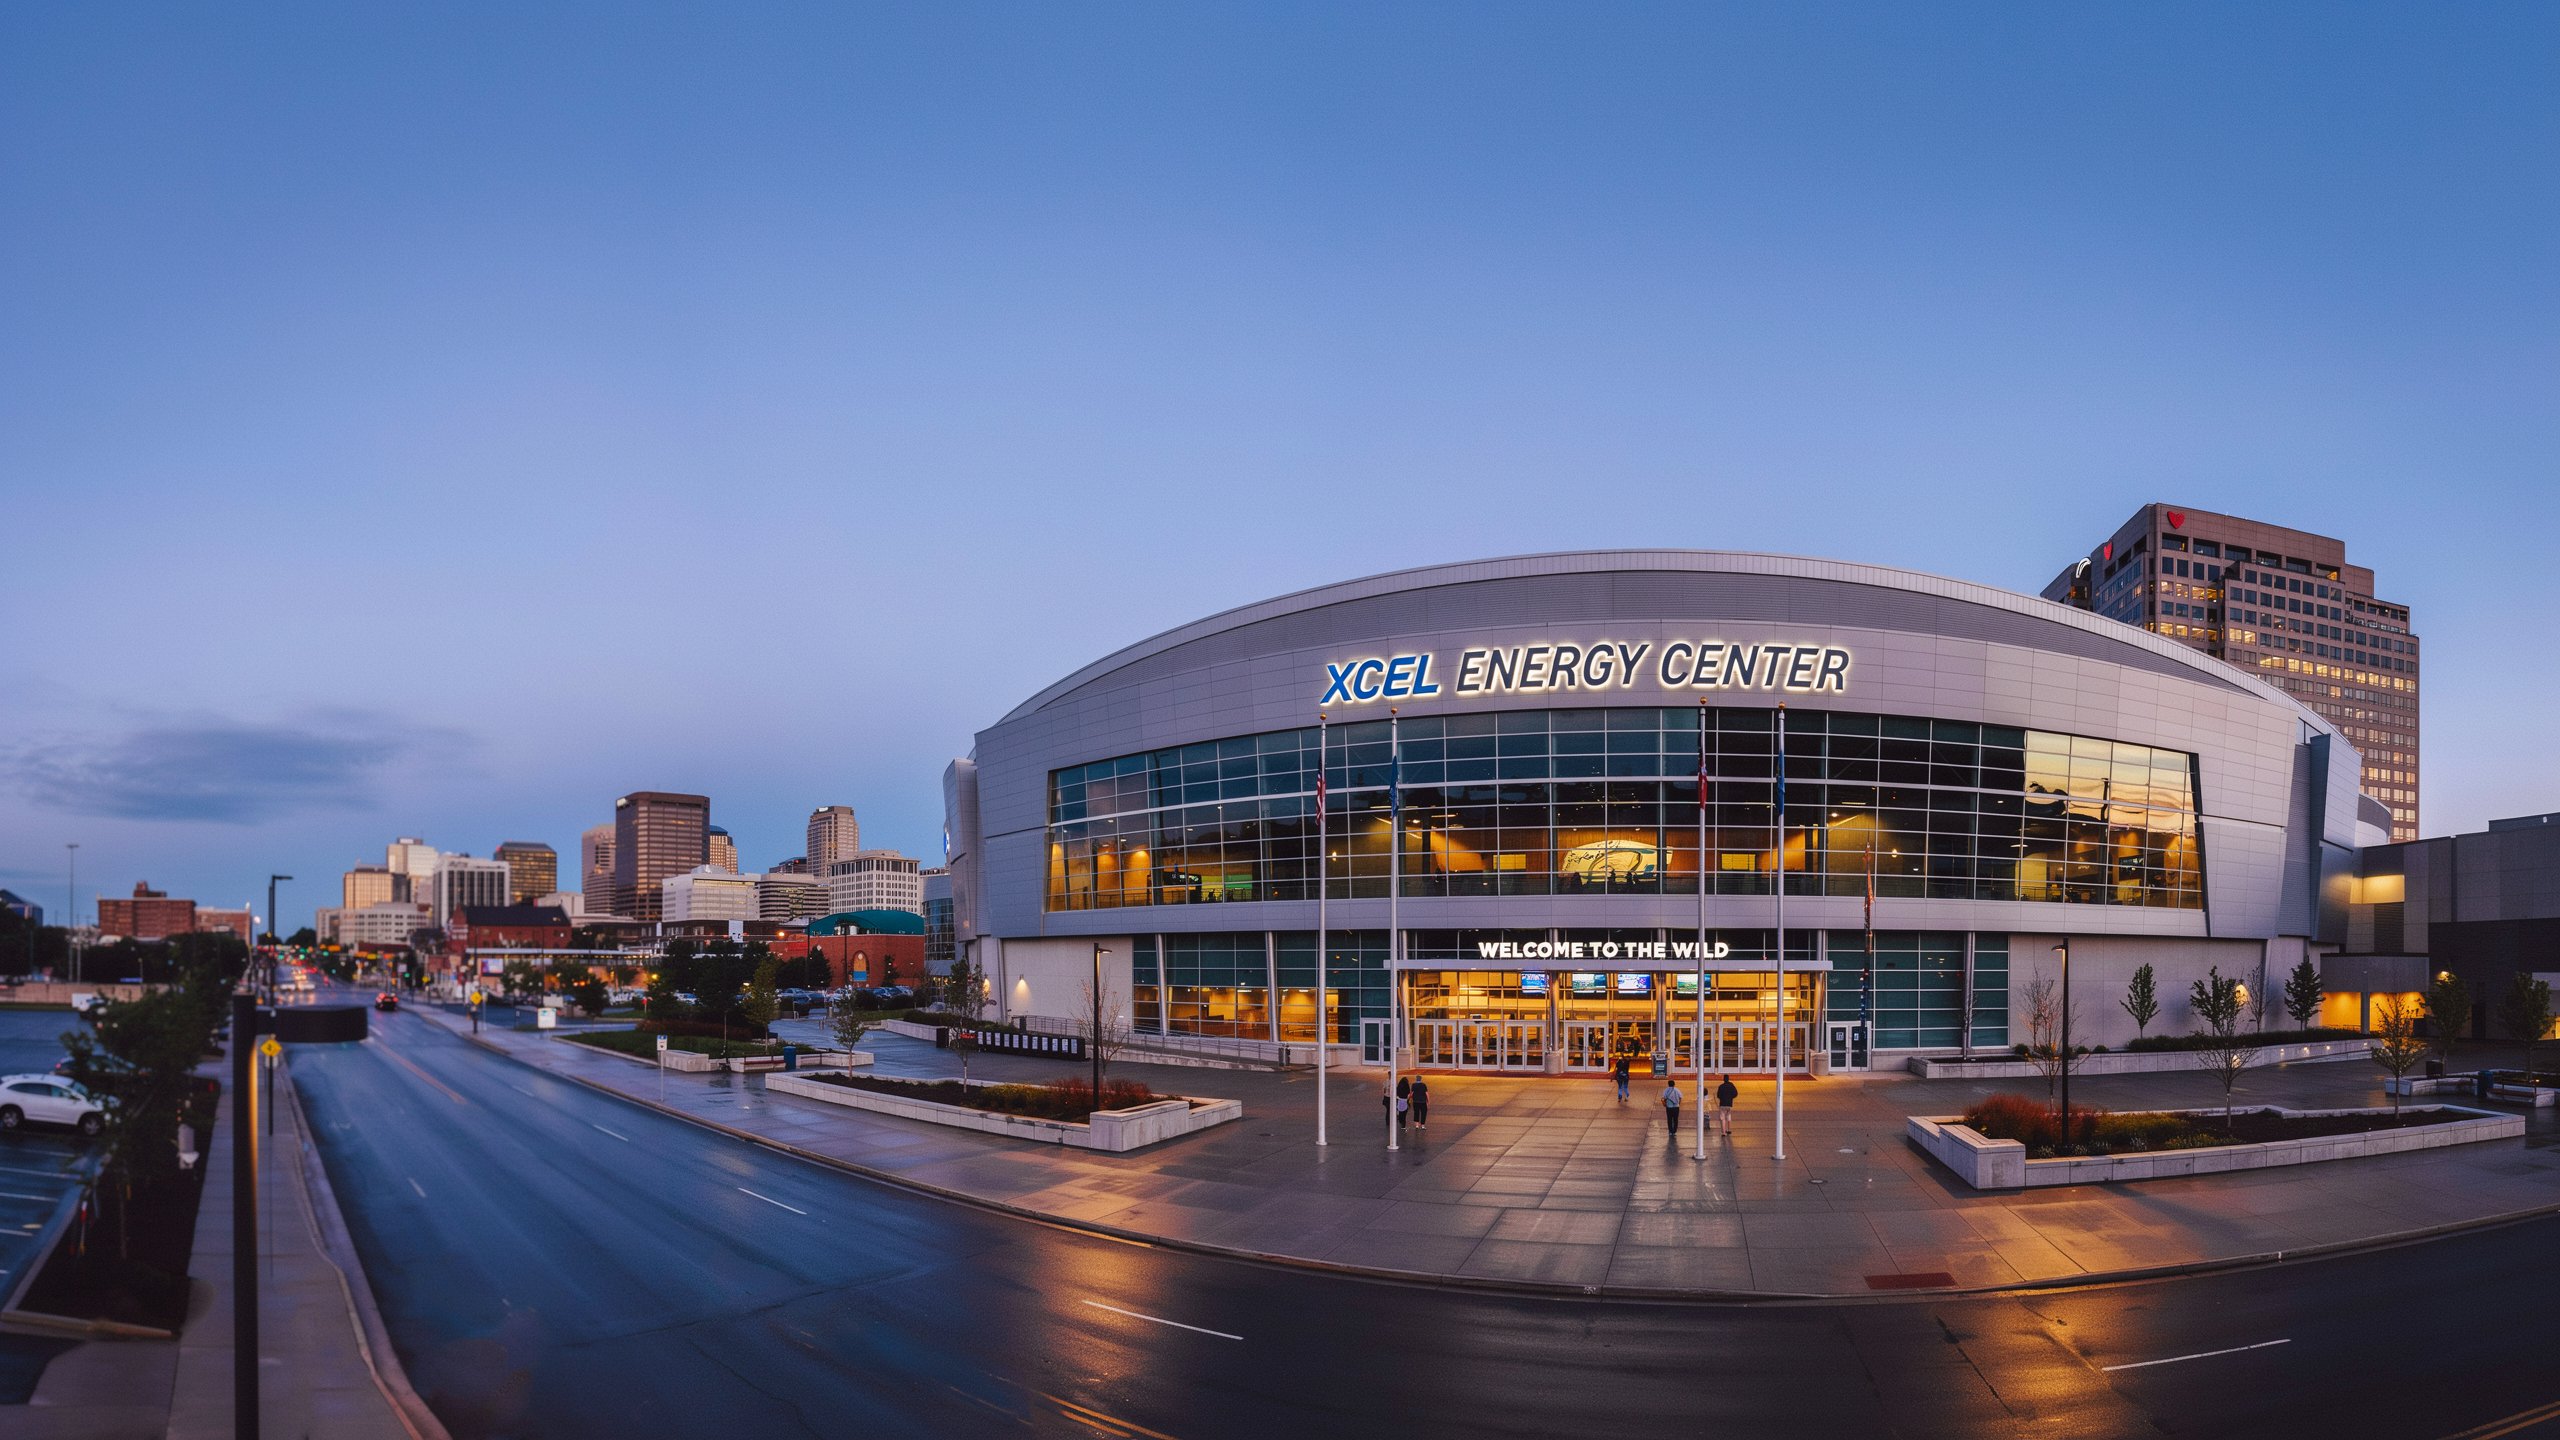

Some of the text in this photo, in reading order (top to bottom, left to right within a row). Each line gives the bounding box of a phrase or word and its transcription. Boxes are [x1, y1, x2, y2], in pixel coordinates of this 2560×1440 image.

[1320, 642, 1849, 704] XCEL ENERGY CENTER
[1478, 942, 1729, 958] WELCOME TO THE WILD
